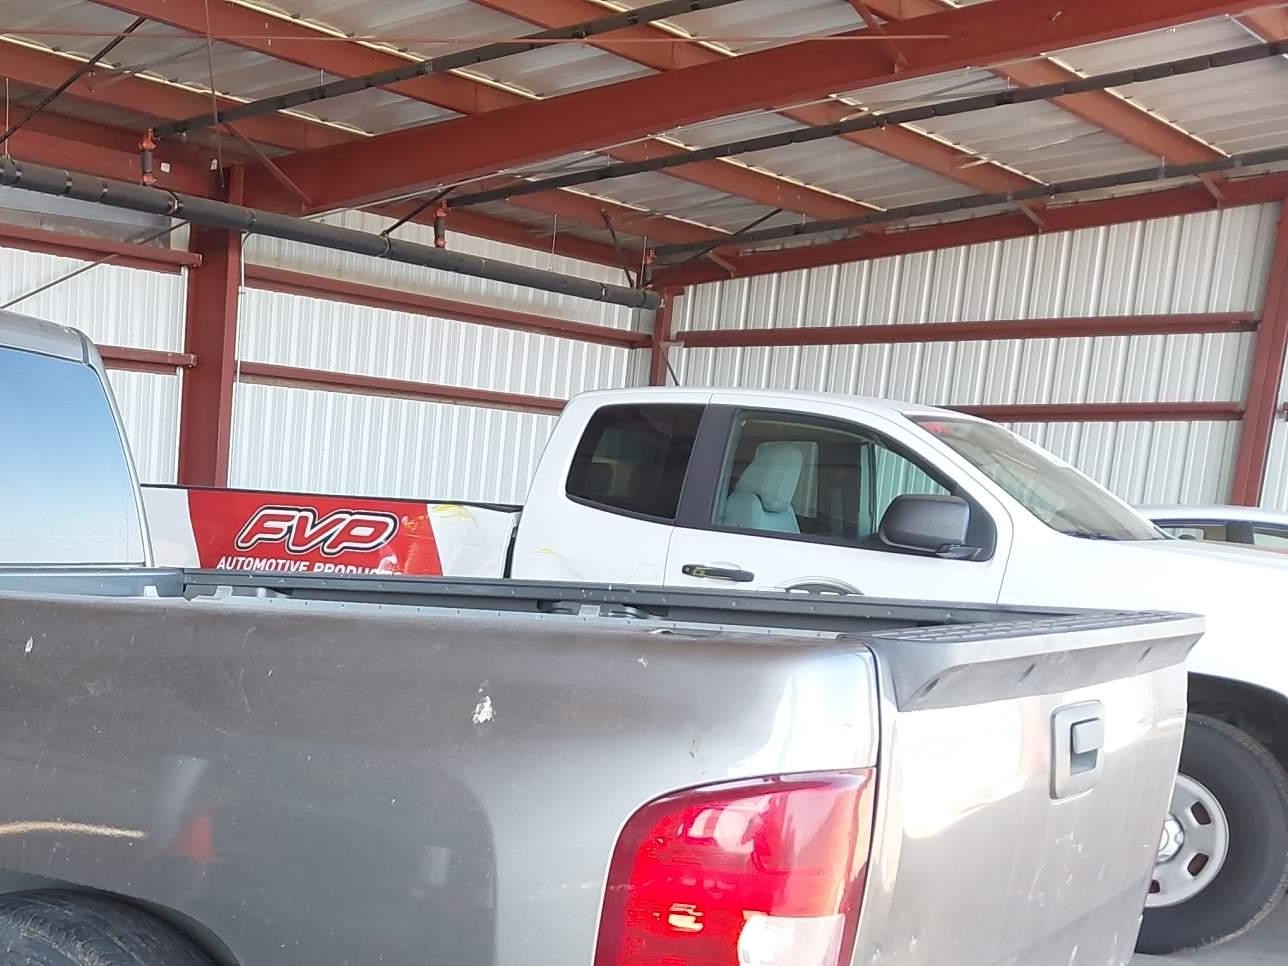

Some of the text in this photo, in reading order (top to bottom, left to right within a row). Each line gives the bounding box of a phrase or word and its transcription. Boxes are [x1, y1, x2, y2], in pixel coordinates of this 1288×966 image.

[236, 505, 399, 556] FVP
[216, 556, 403, 576] AUTOMOTIVE PRODU
